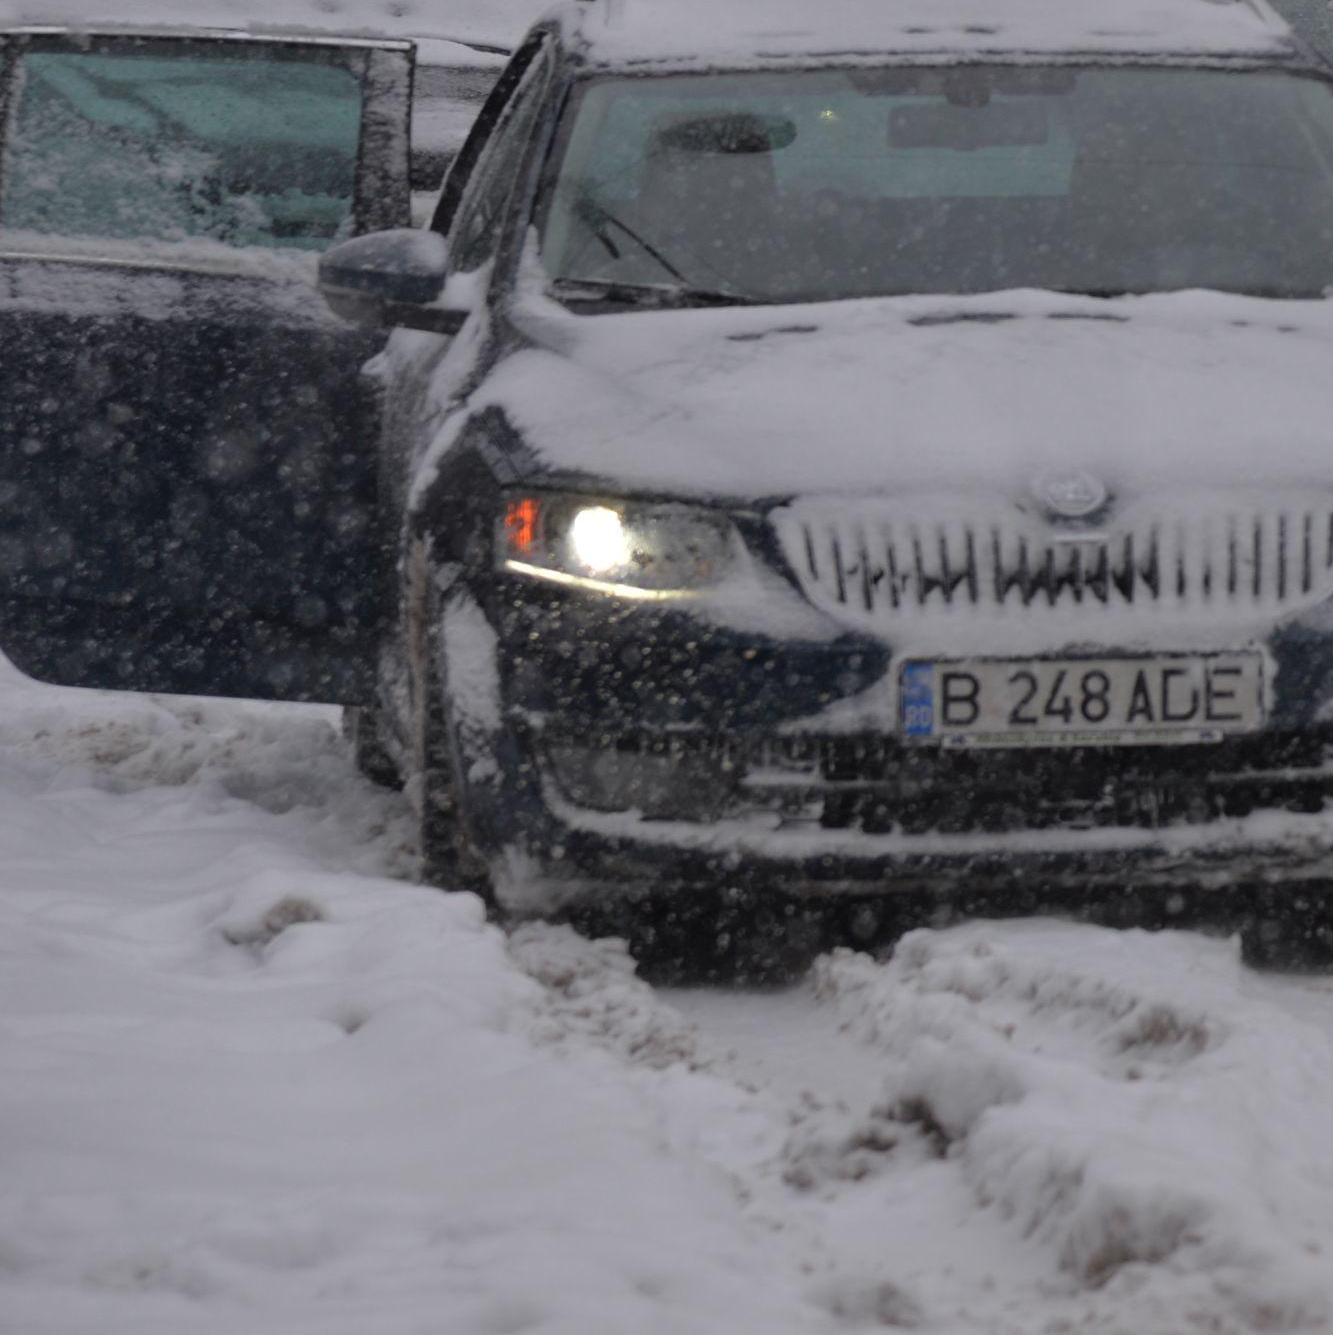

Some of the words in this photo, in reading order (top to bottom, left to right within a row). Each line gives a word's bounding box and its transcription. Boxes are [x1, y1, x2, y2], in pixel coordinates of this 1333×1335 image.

[942, 670, 981, 727] B
[1008, 669, 1111, 725] 248
[1127, 667, 1243, 723] ADE
